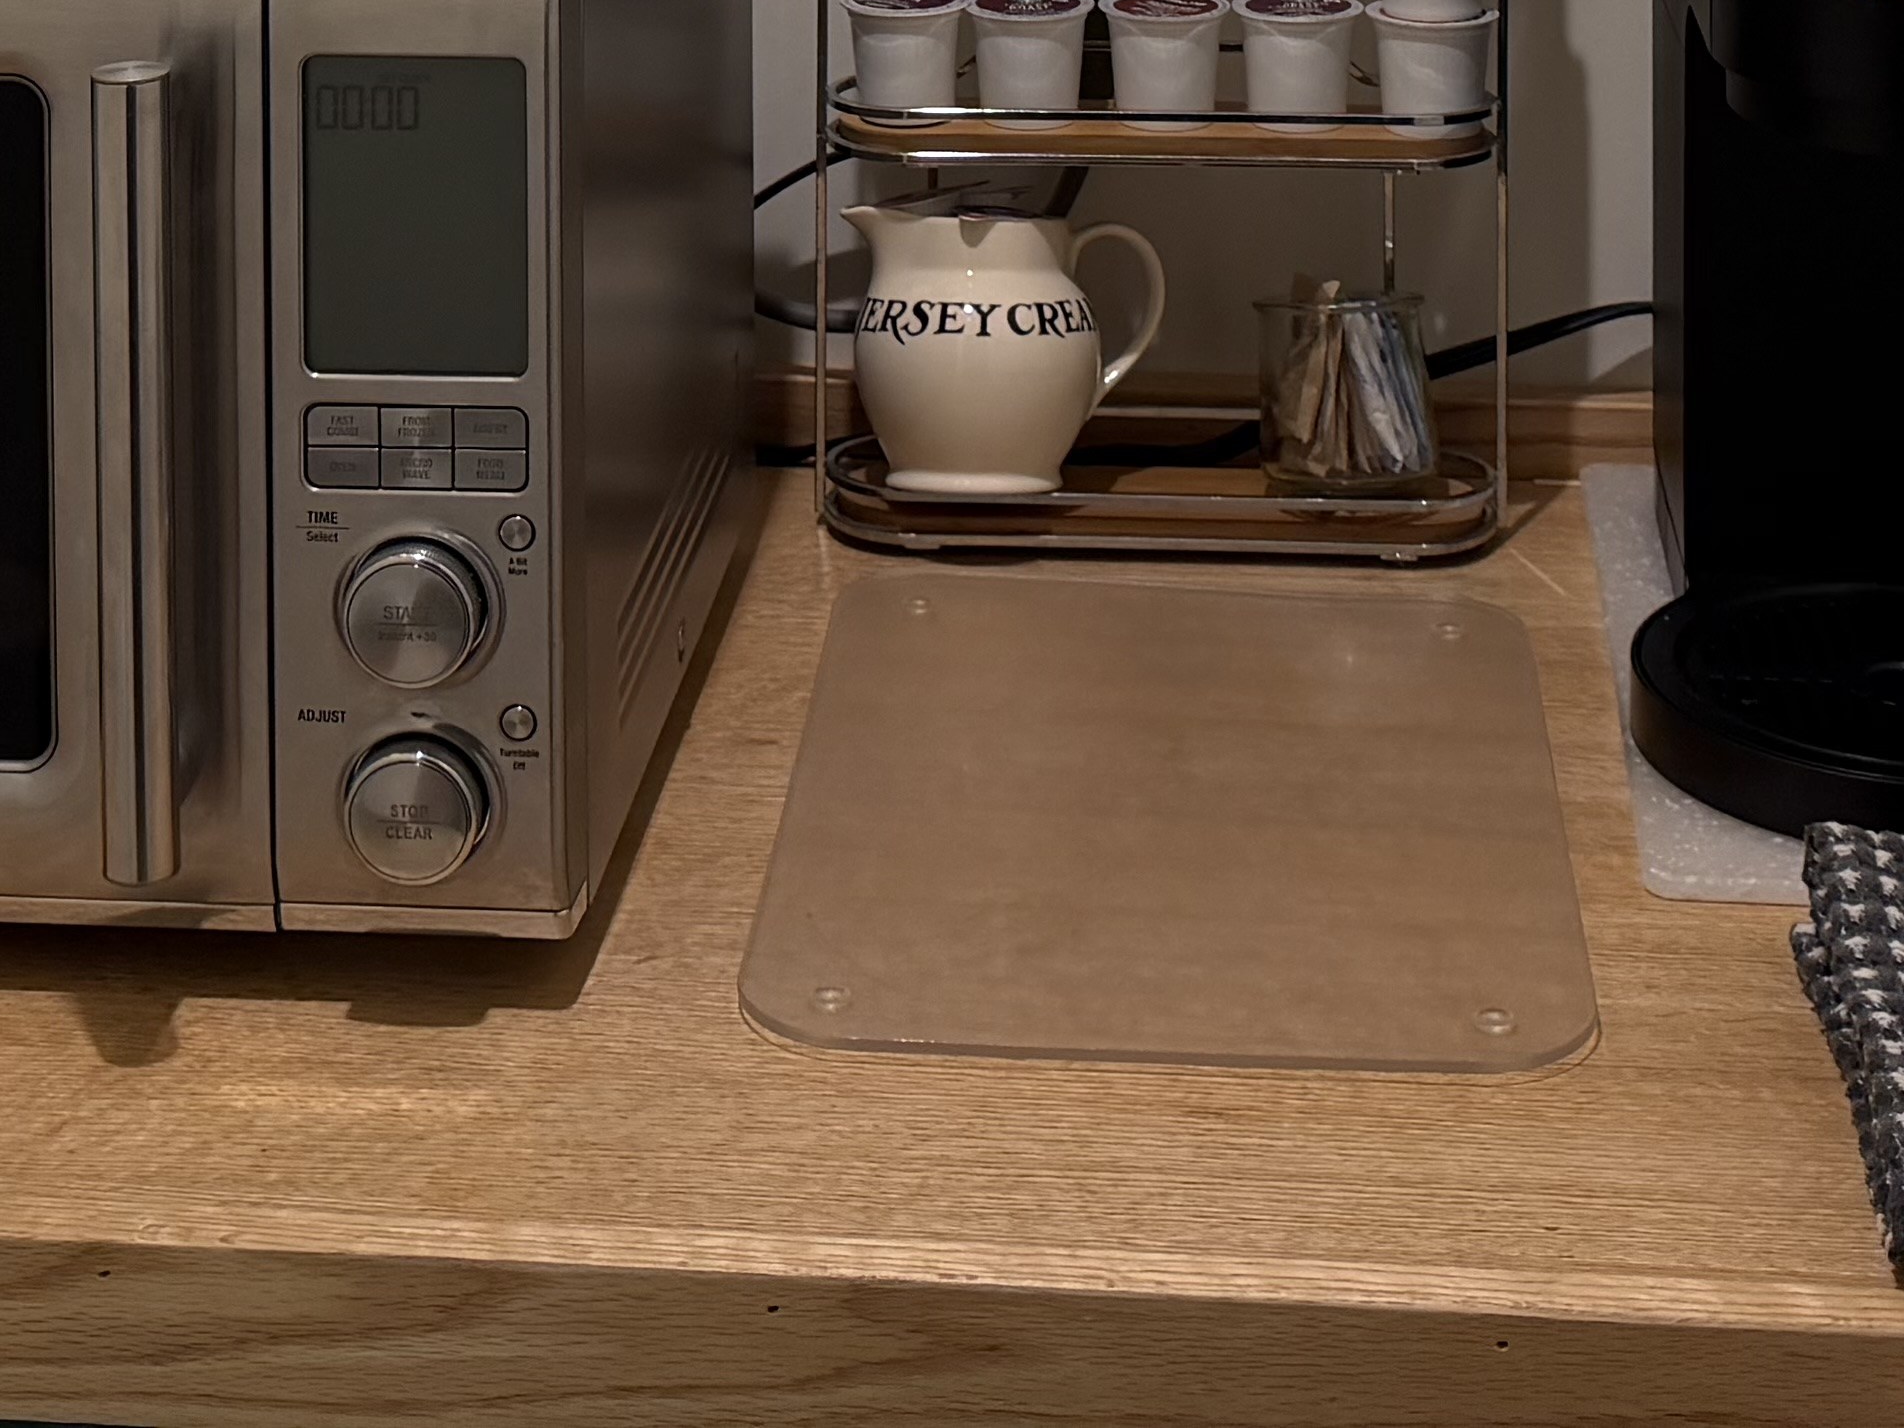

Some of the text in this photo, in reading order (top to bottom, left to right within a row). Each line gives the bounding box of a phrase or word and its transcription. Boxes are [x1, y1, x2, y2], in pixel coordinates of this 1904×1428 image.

[1006, 297, 1096, 338] CREA
[306, 510, 339, 525] TIME
[305, 530, 340, 544] Select
[297, 707, 346, 724] ADJUST
[499, 747, 540, 760] Turntable
[384, 825, 433, 841] CLEAR
